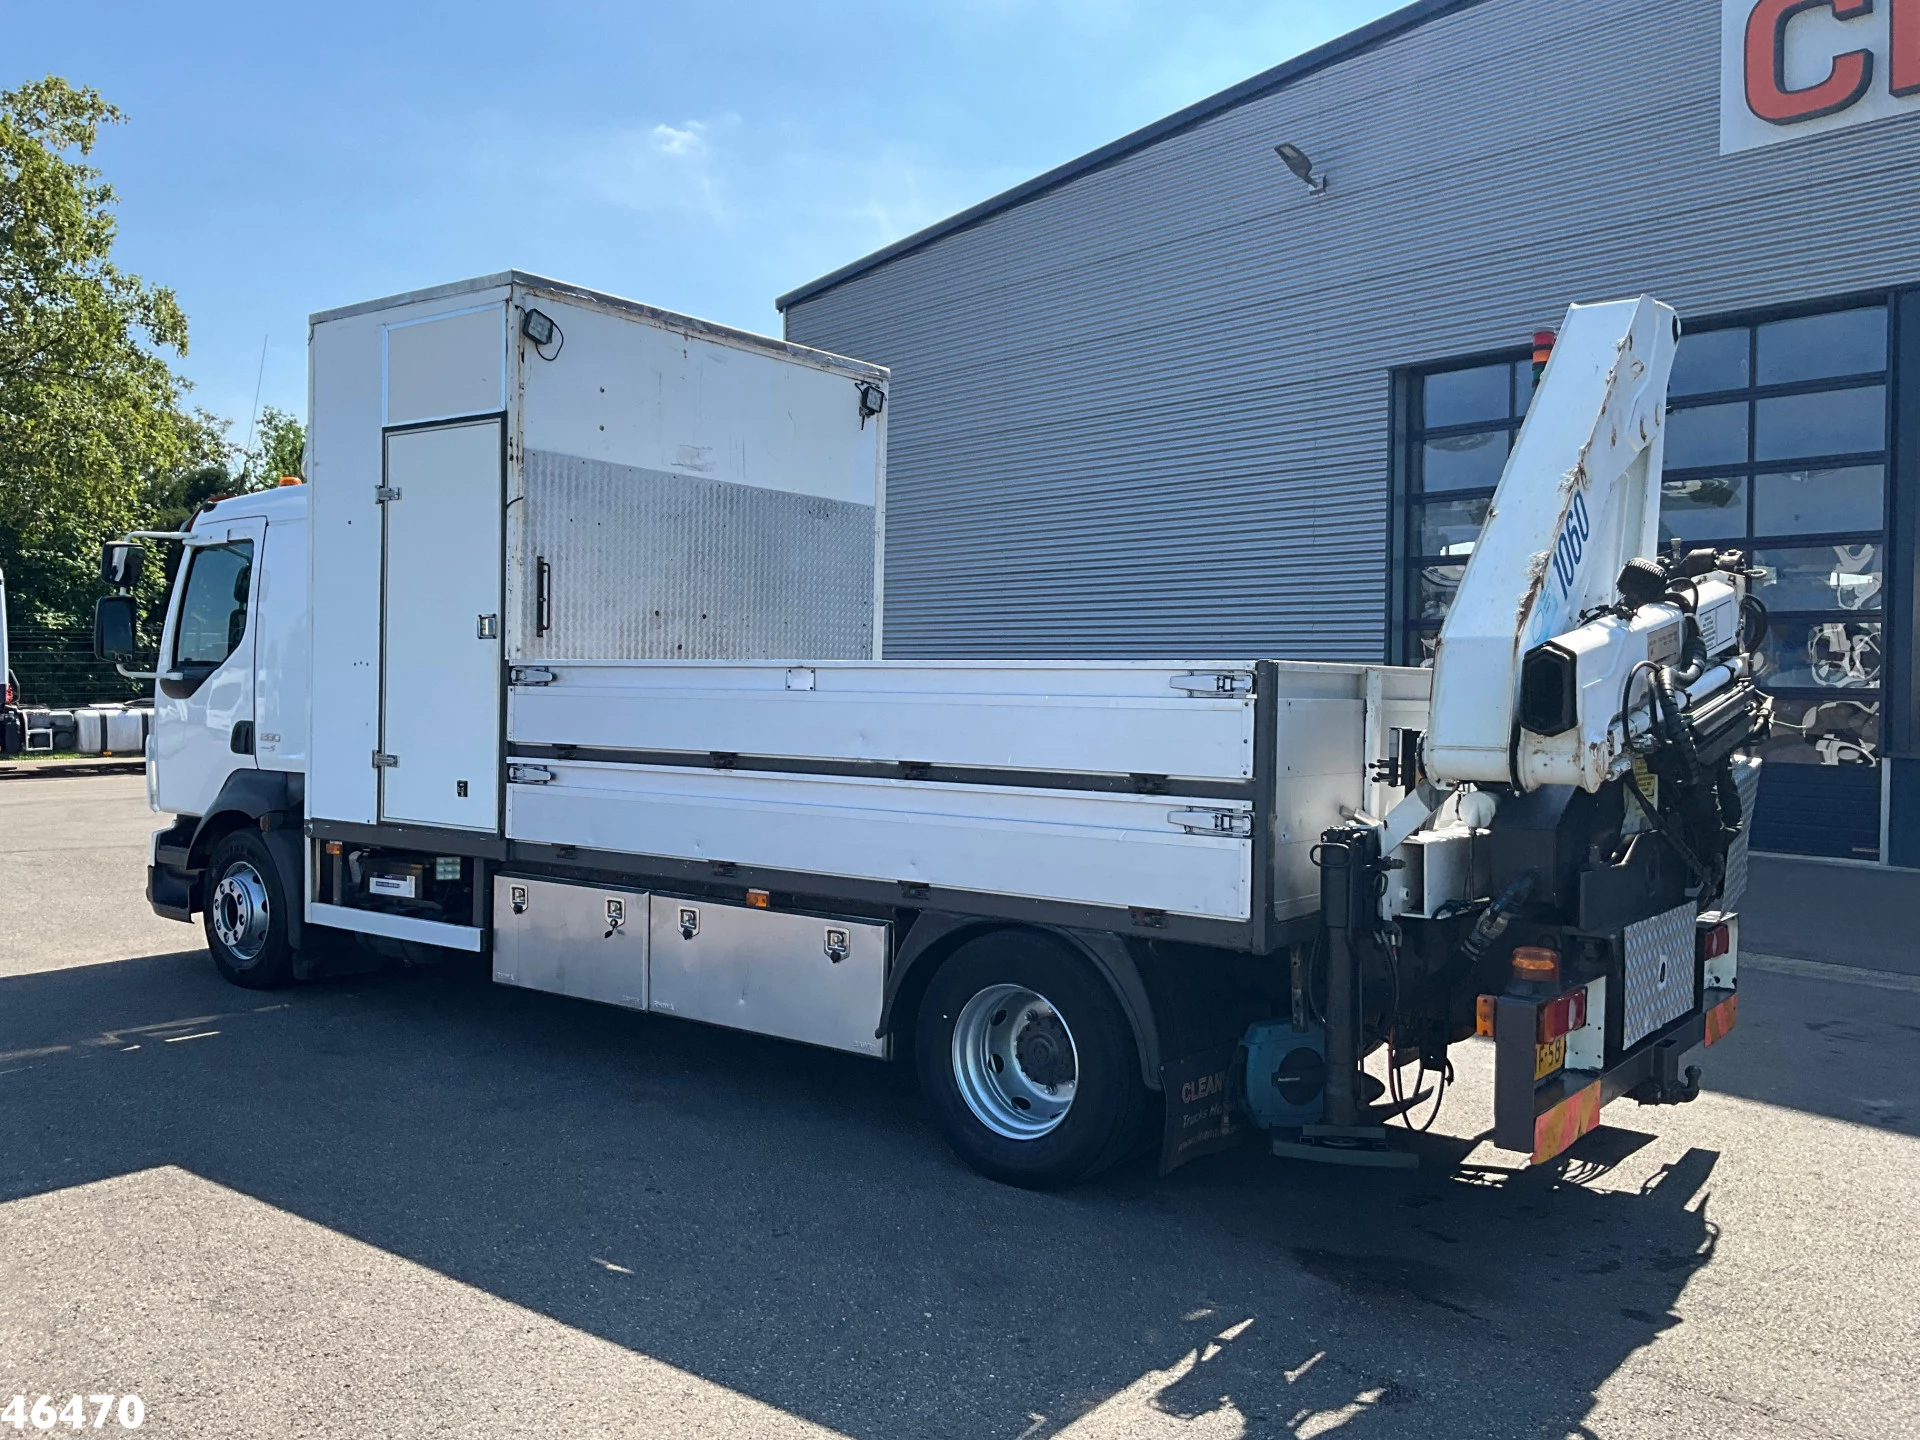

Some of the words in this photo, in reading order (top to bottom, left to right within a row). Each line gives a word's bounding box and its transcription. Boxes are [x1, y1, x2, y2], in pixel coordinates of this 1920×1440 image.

[1744, 0, 1920, 125] C
[1553, 489, 1590, 601] 1060
[1181, 1071, 1226, 1104] CLEAN
